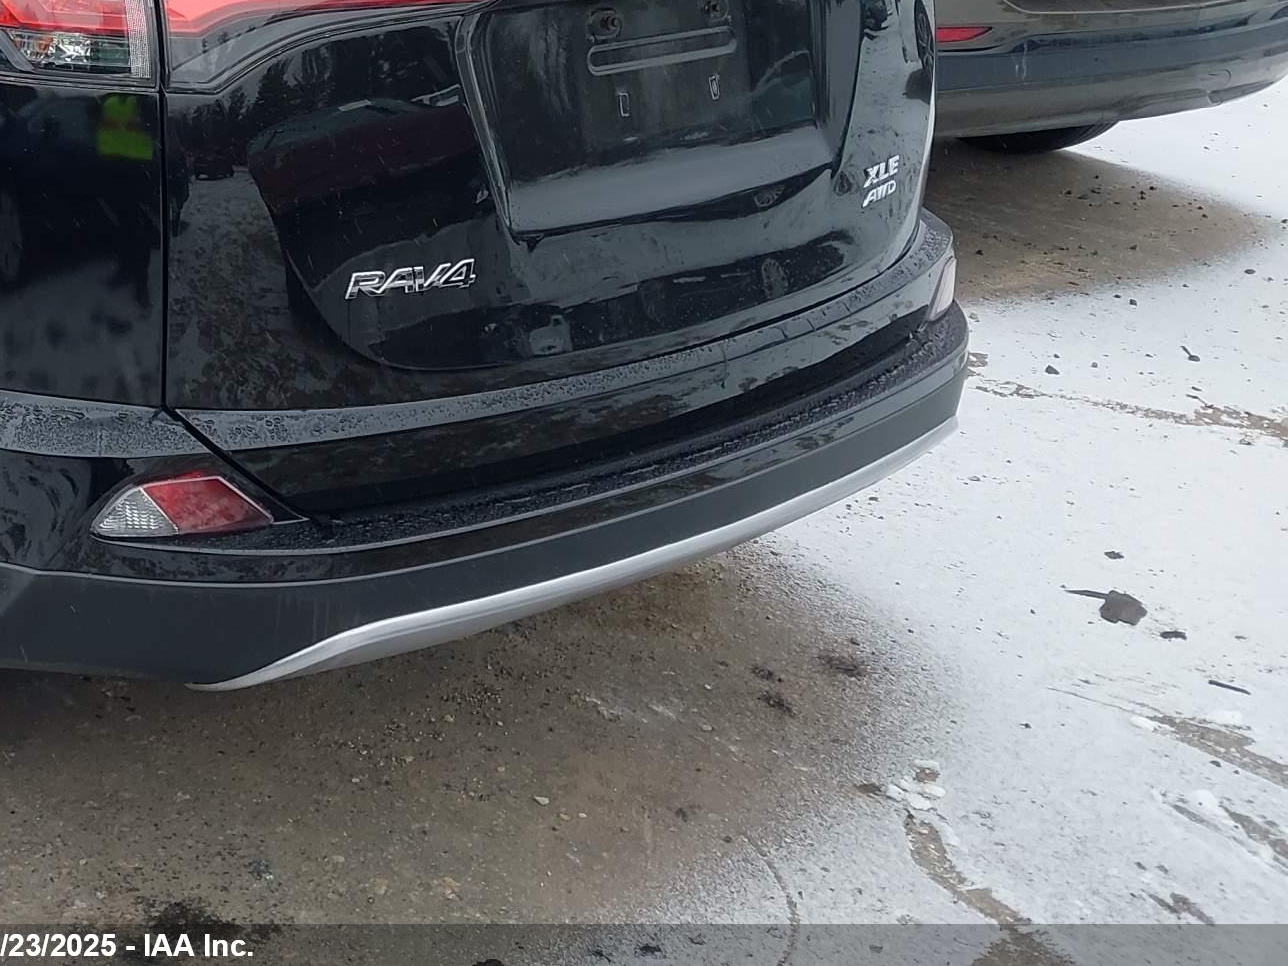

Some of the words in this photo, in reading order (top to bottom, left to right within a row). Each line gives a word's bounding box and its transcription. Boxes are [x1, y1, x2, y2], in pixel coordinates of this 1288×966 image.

[863, 155, 899, 188] XLE
[862, 180, 896, 207] AWD
[345, 259, 476, 299] RAV4
